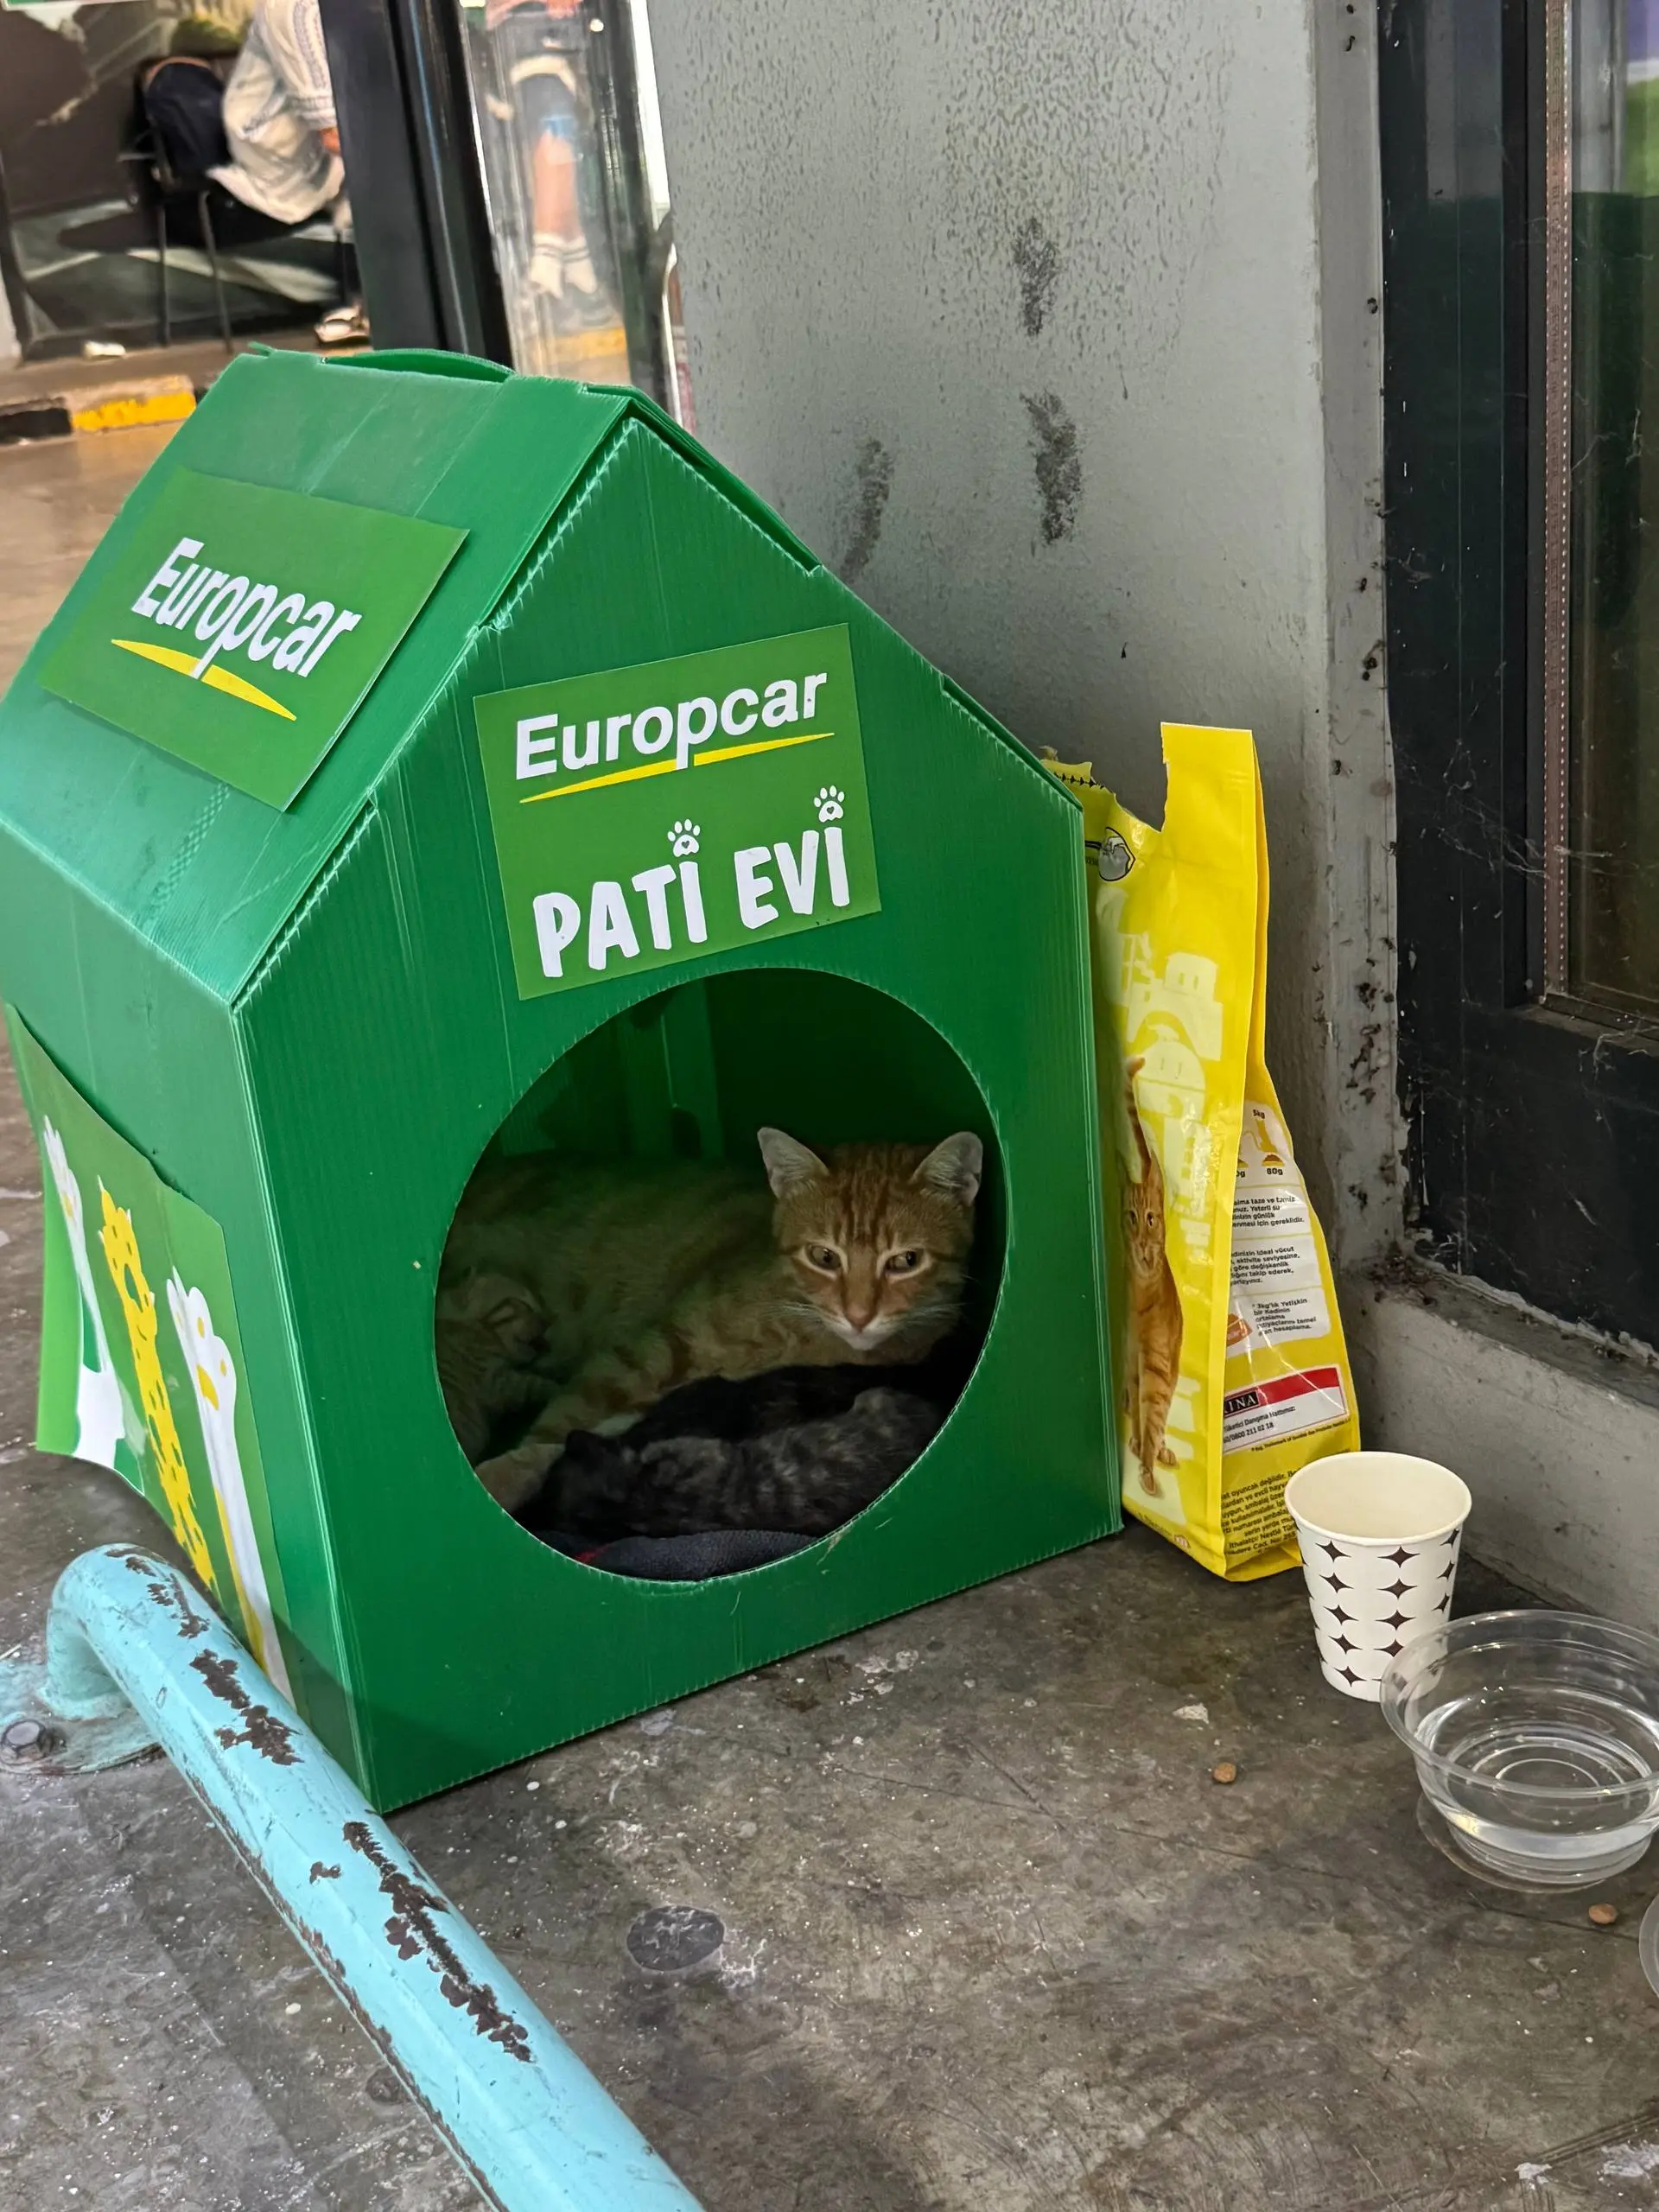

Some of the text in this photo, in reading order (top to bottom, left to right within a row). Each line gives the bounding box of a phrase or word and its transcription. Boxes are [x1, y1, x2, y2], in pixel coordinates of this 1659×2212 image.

[131, 537, 362, 680] Europcar
[516, 672, 828, 779] Europcar
[1224, 1394, 1256, 1414] INA
[1245, 1426, 1257, 1436] 211
[1257, 1424, 1266, 1433] 02
